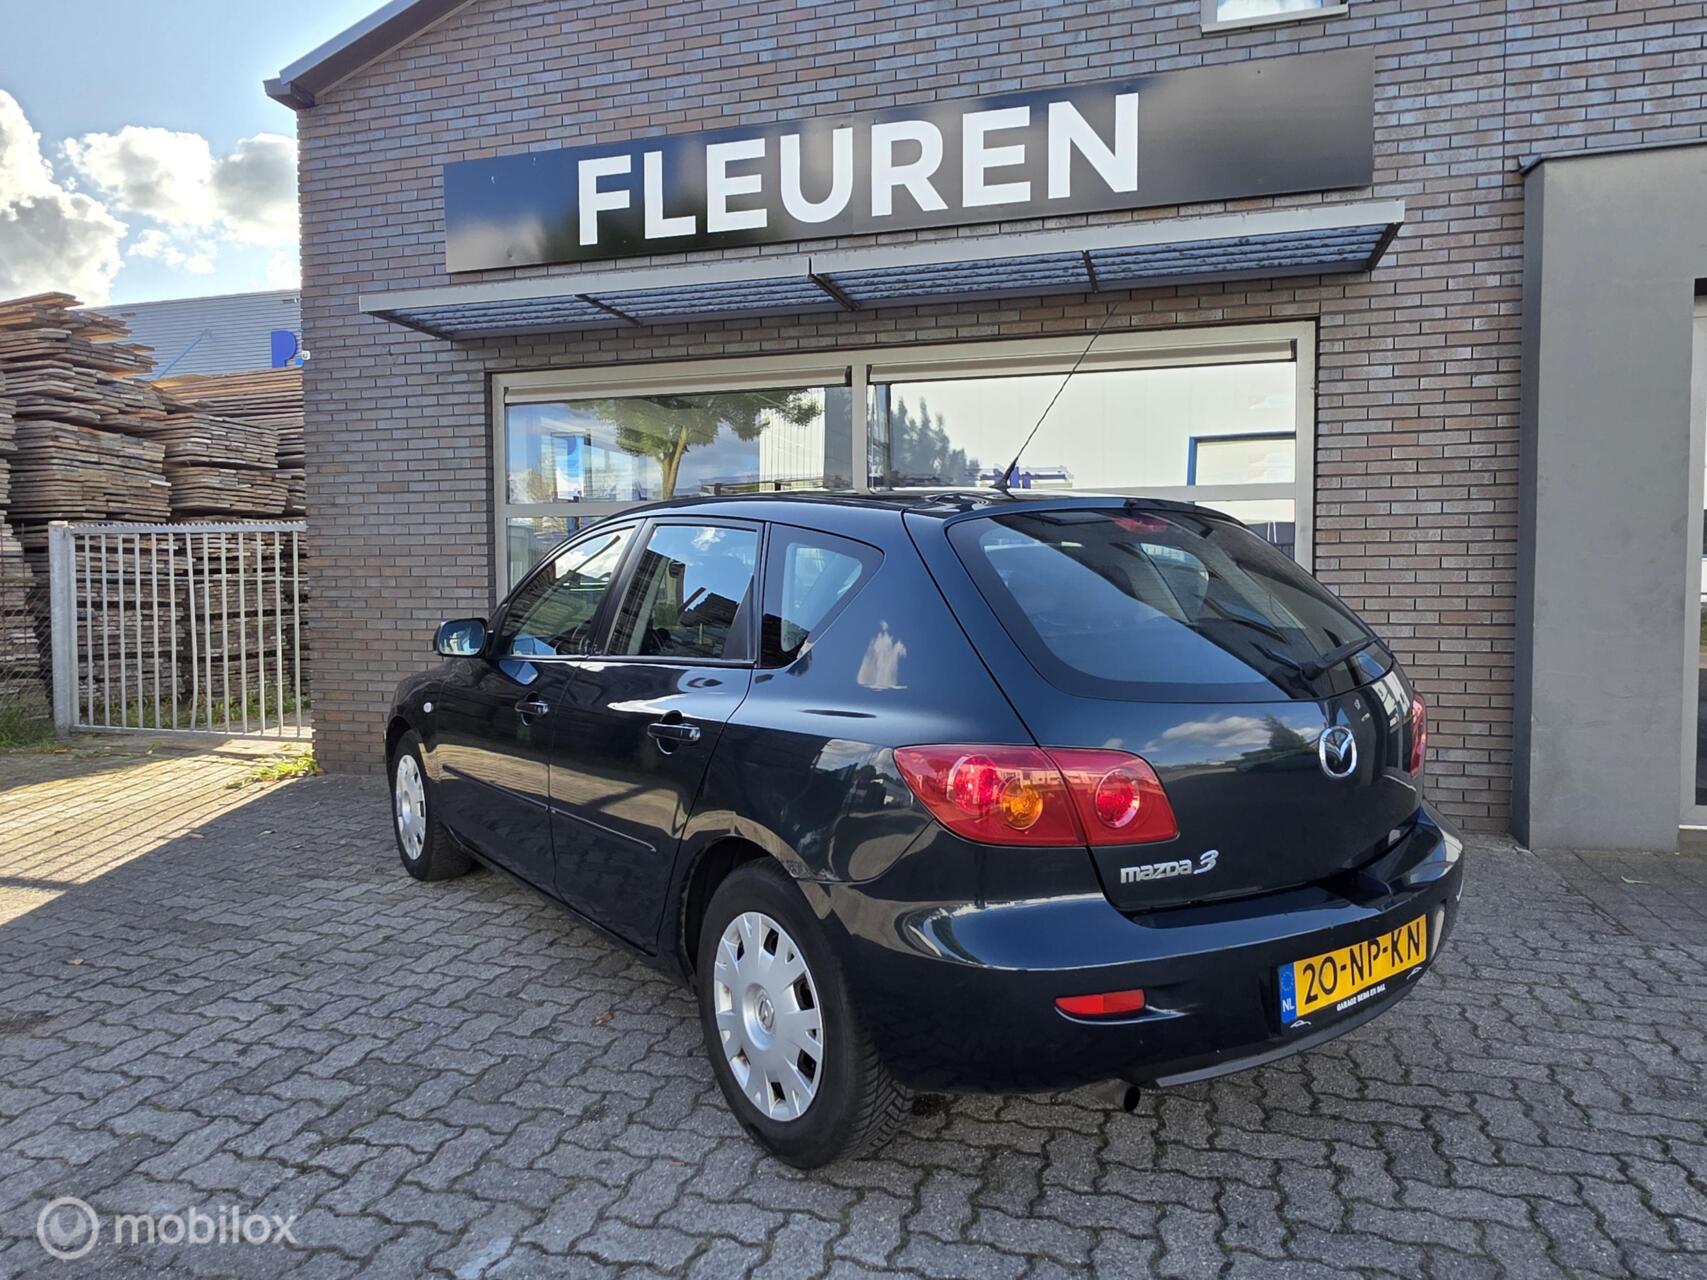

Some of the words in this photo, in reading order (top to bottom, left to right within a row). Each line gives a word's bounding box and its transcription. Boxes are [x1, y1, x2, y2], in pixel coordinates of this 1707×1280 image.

[578, 92, 1139, 246] FLEUREN
[1282, 997, 1295, 1013] NL
[1302, 921, 1420, 1006] 20-NP-KN
